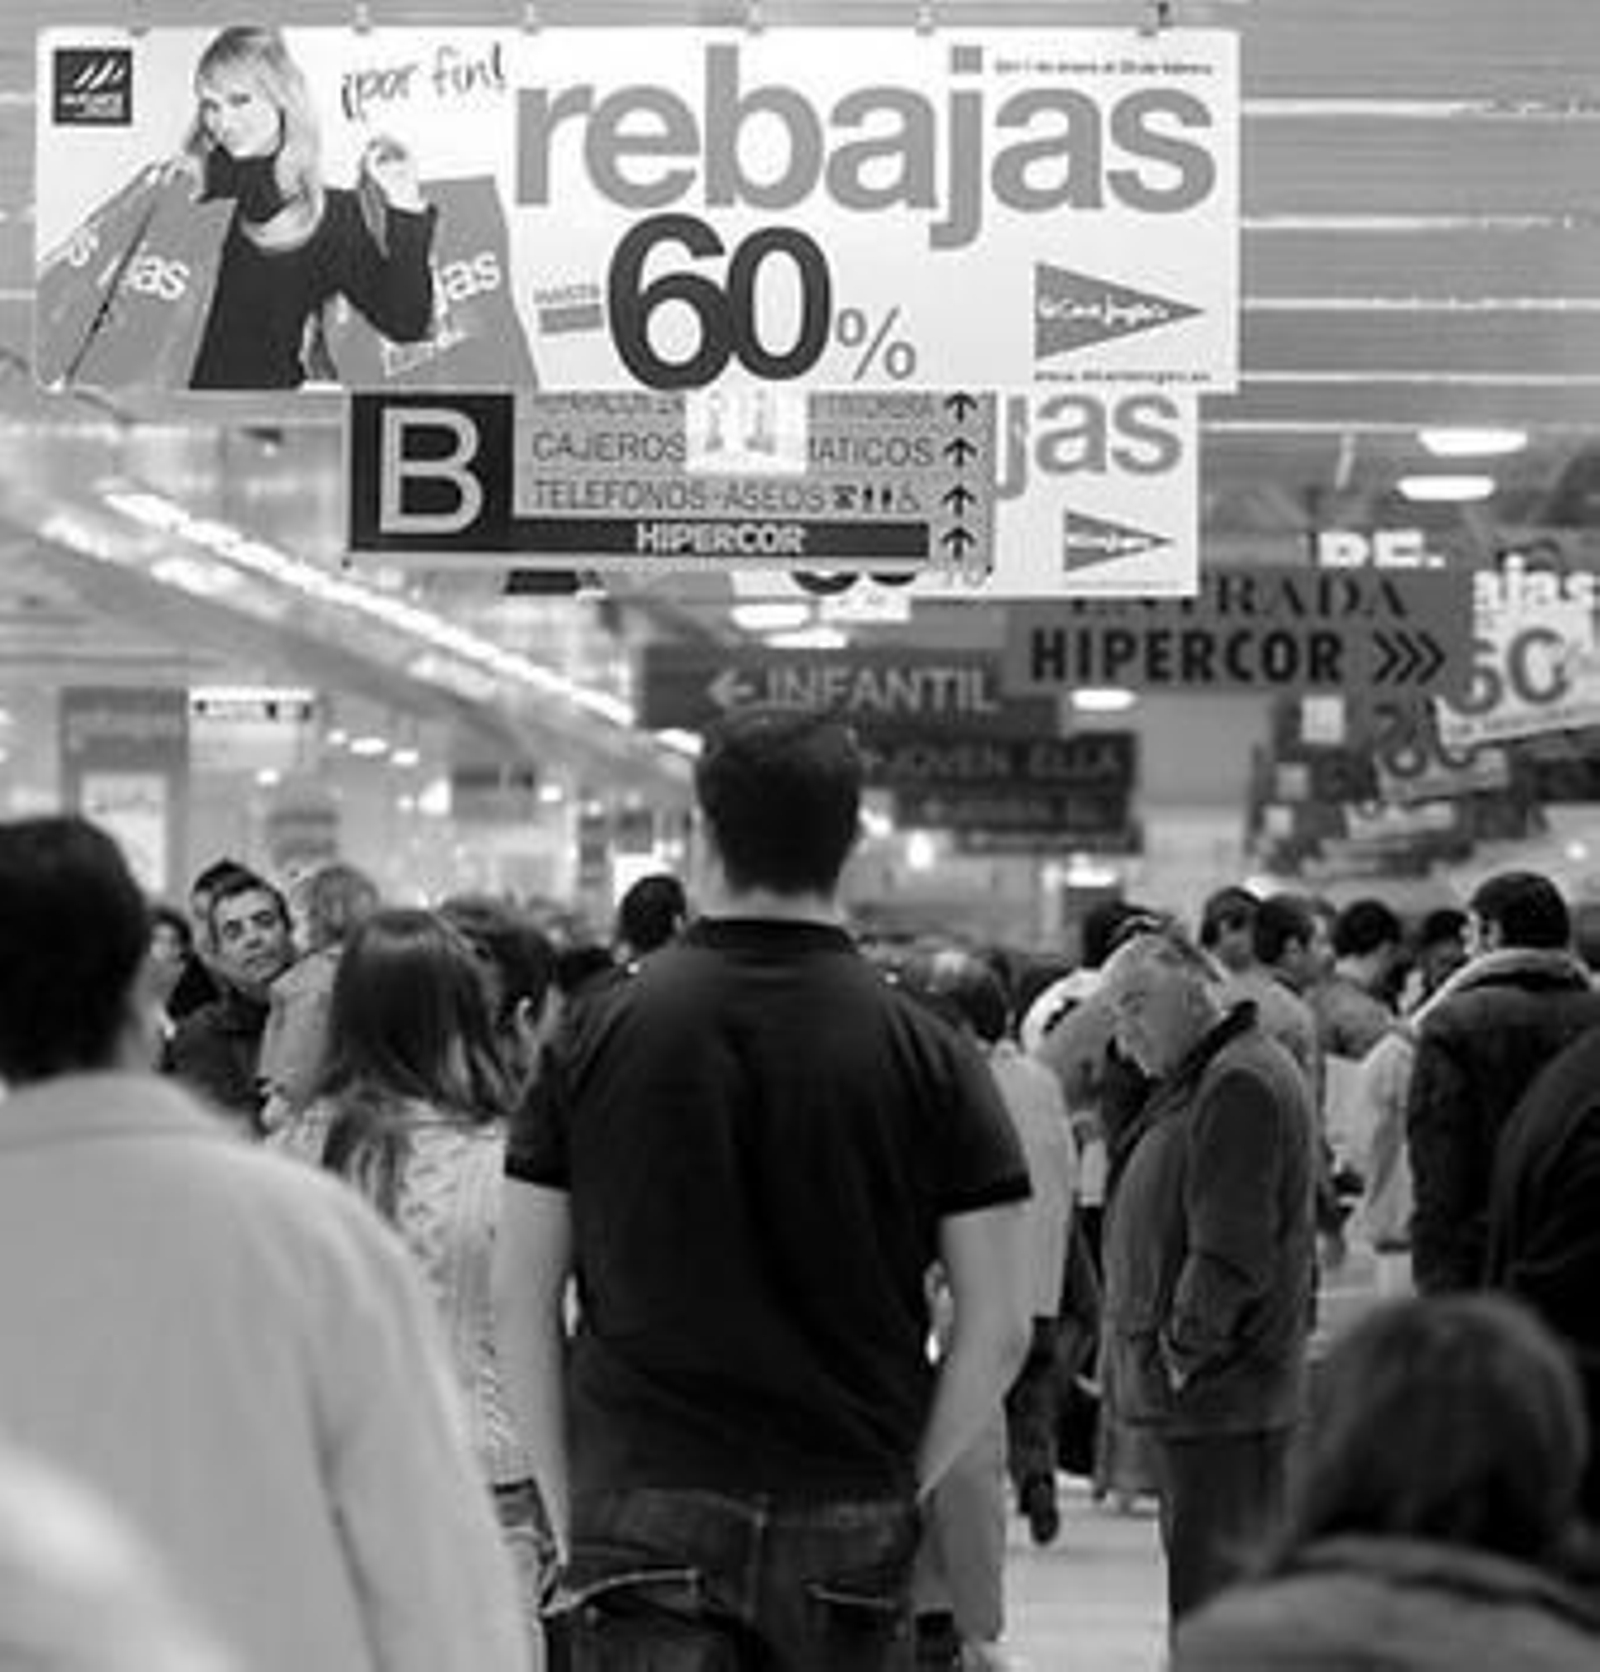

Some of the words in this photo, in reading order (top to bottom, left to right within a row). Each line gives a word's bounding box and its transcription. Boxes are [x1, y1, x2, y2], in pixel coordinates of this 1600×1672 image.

[514, 44, 1217, 250] rebajas
[378, 407, 482, 537] B
[532, 433, 687, 468] CAJEROS
[635, 522, 806, 555] HIPERCOR
[1030, 629, 1343, 684] HIPERCOR
[764, 668, 997, 713] INFANTIL
